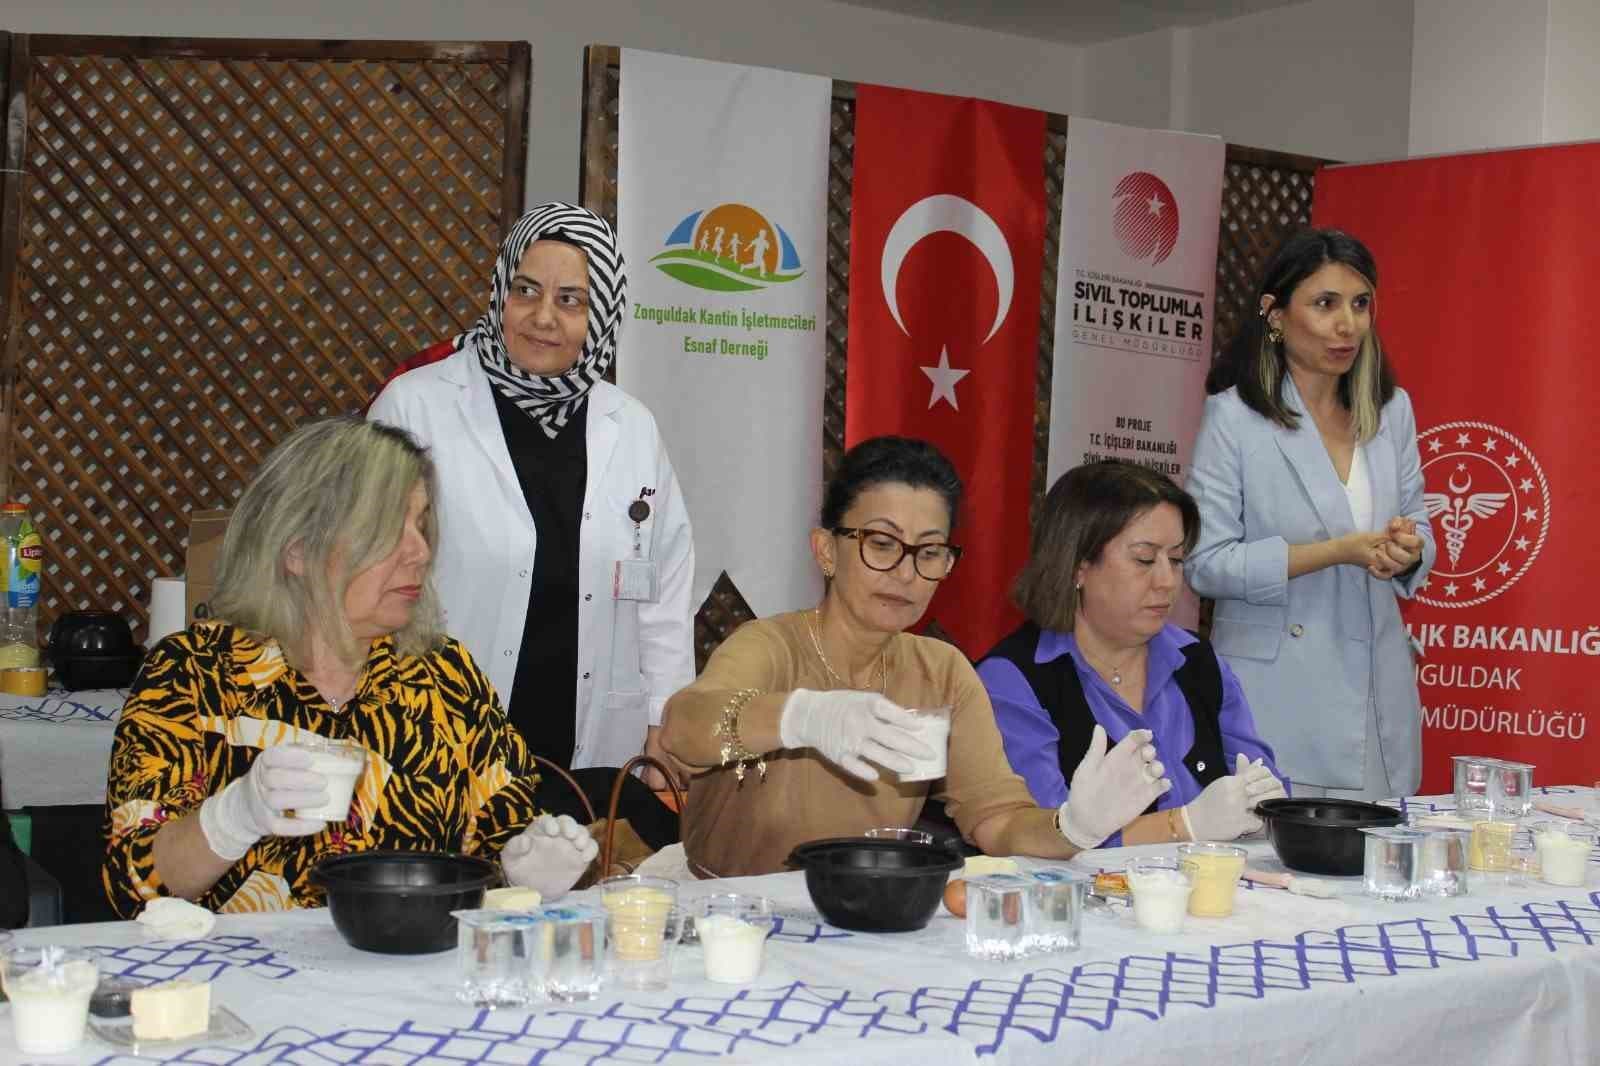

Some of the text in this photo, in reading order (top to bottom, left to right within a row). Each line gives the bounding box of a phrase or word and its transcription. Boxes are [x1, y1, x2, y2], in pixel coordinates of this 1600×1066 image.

[1074, 280, 1203, 319] SİVİL TOPLUMLA
[633, 303, 817, 331] Zonguldak Kantin İşletmecileri
[1073, 303, 1203, 341] İLİŞKİLER
[684, 336, 768, 360] Esnaf Derneği
[1116, 416, 1152, 432] BU PROJE
[1104, 433, 1134, 451] İÇİŞLERİ
[1136, 440, 1177, 455] BAKANLIĞI
[1453, 625, 1600, 656] BAKANLIĞ
[1415, 664, 1522, 690] GULDAK
[1421, 703, 1586, 740] MÜDÜRLÜĞÜ
